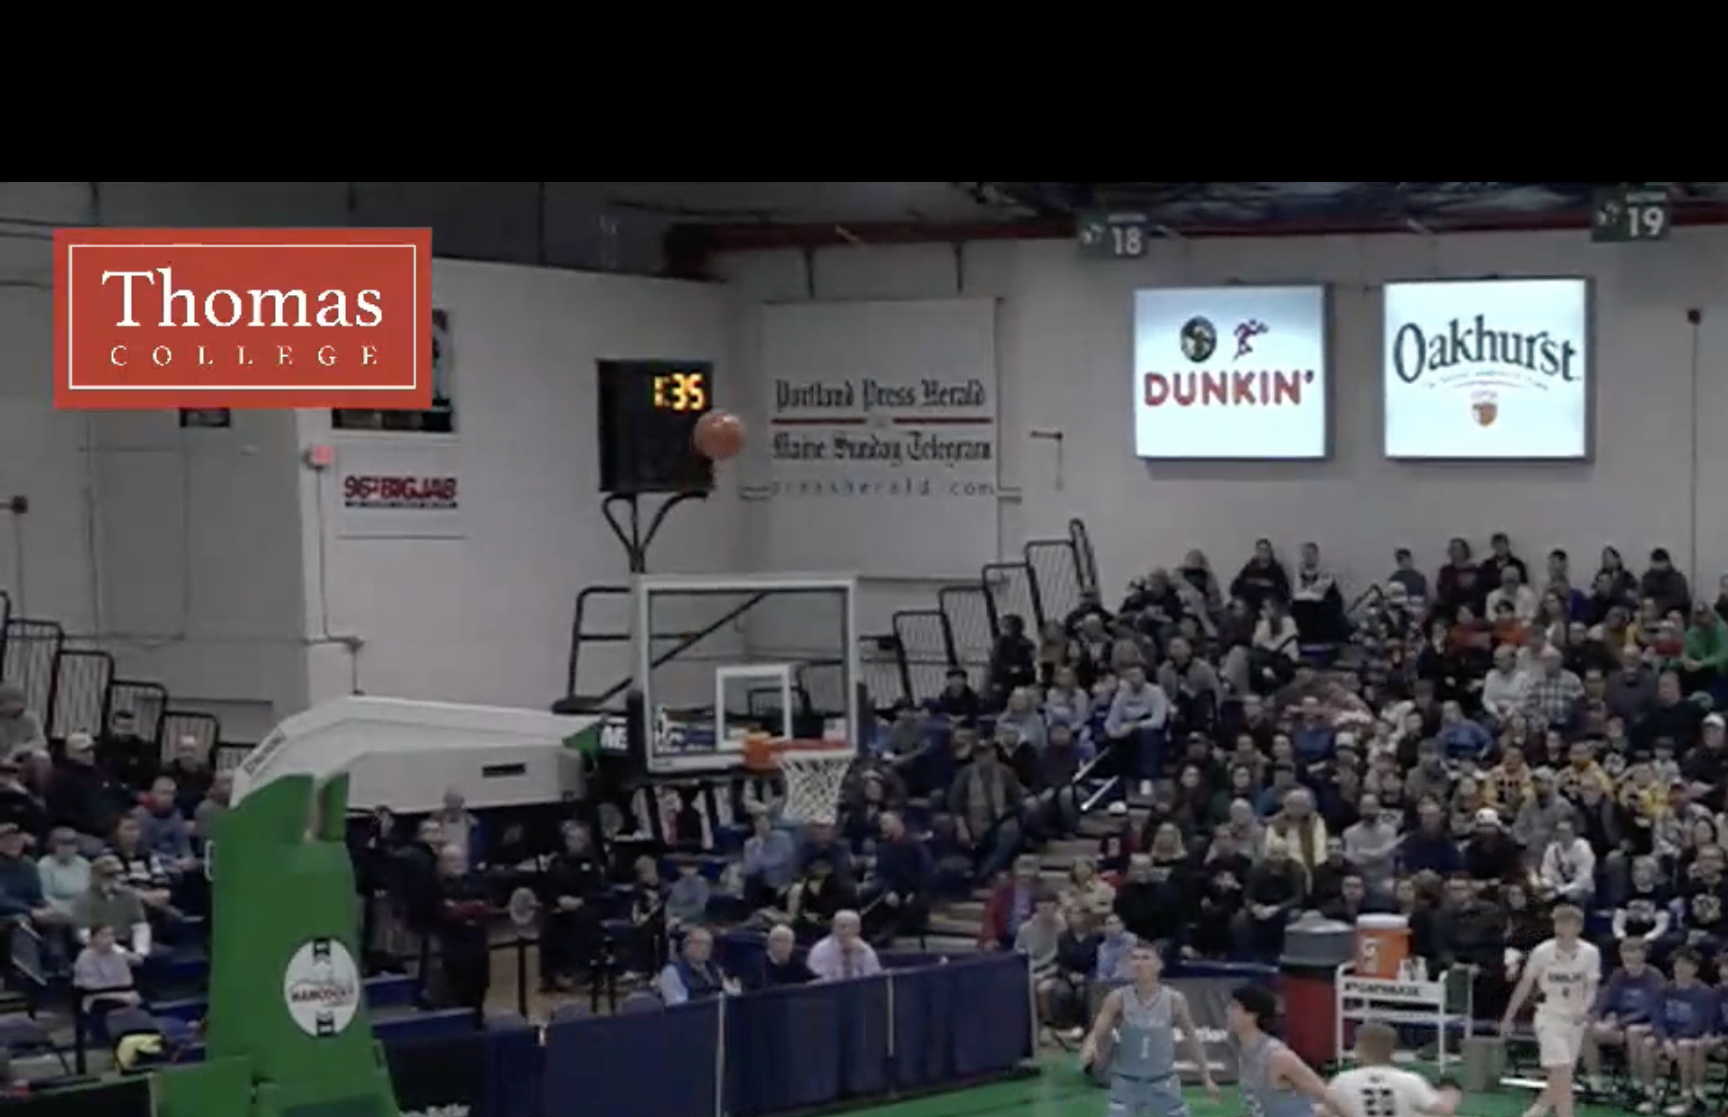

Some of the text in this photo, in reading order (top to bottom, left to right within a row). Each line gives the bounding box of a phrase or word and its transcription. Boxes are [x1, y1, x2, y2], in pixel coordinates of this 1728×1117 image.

[1111, 226, 1142, 255] 18
[1626, 205, 1665, 238] 19
[1393, 312, 1578, 385] Oakhurst
[653, 372, 705, 410] 1:35
[1143, 369, 1315, 407] DUNKIN'
